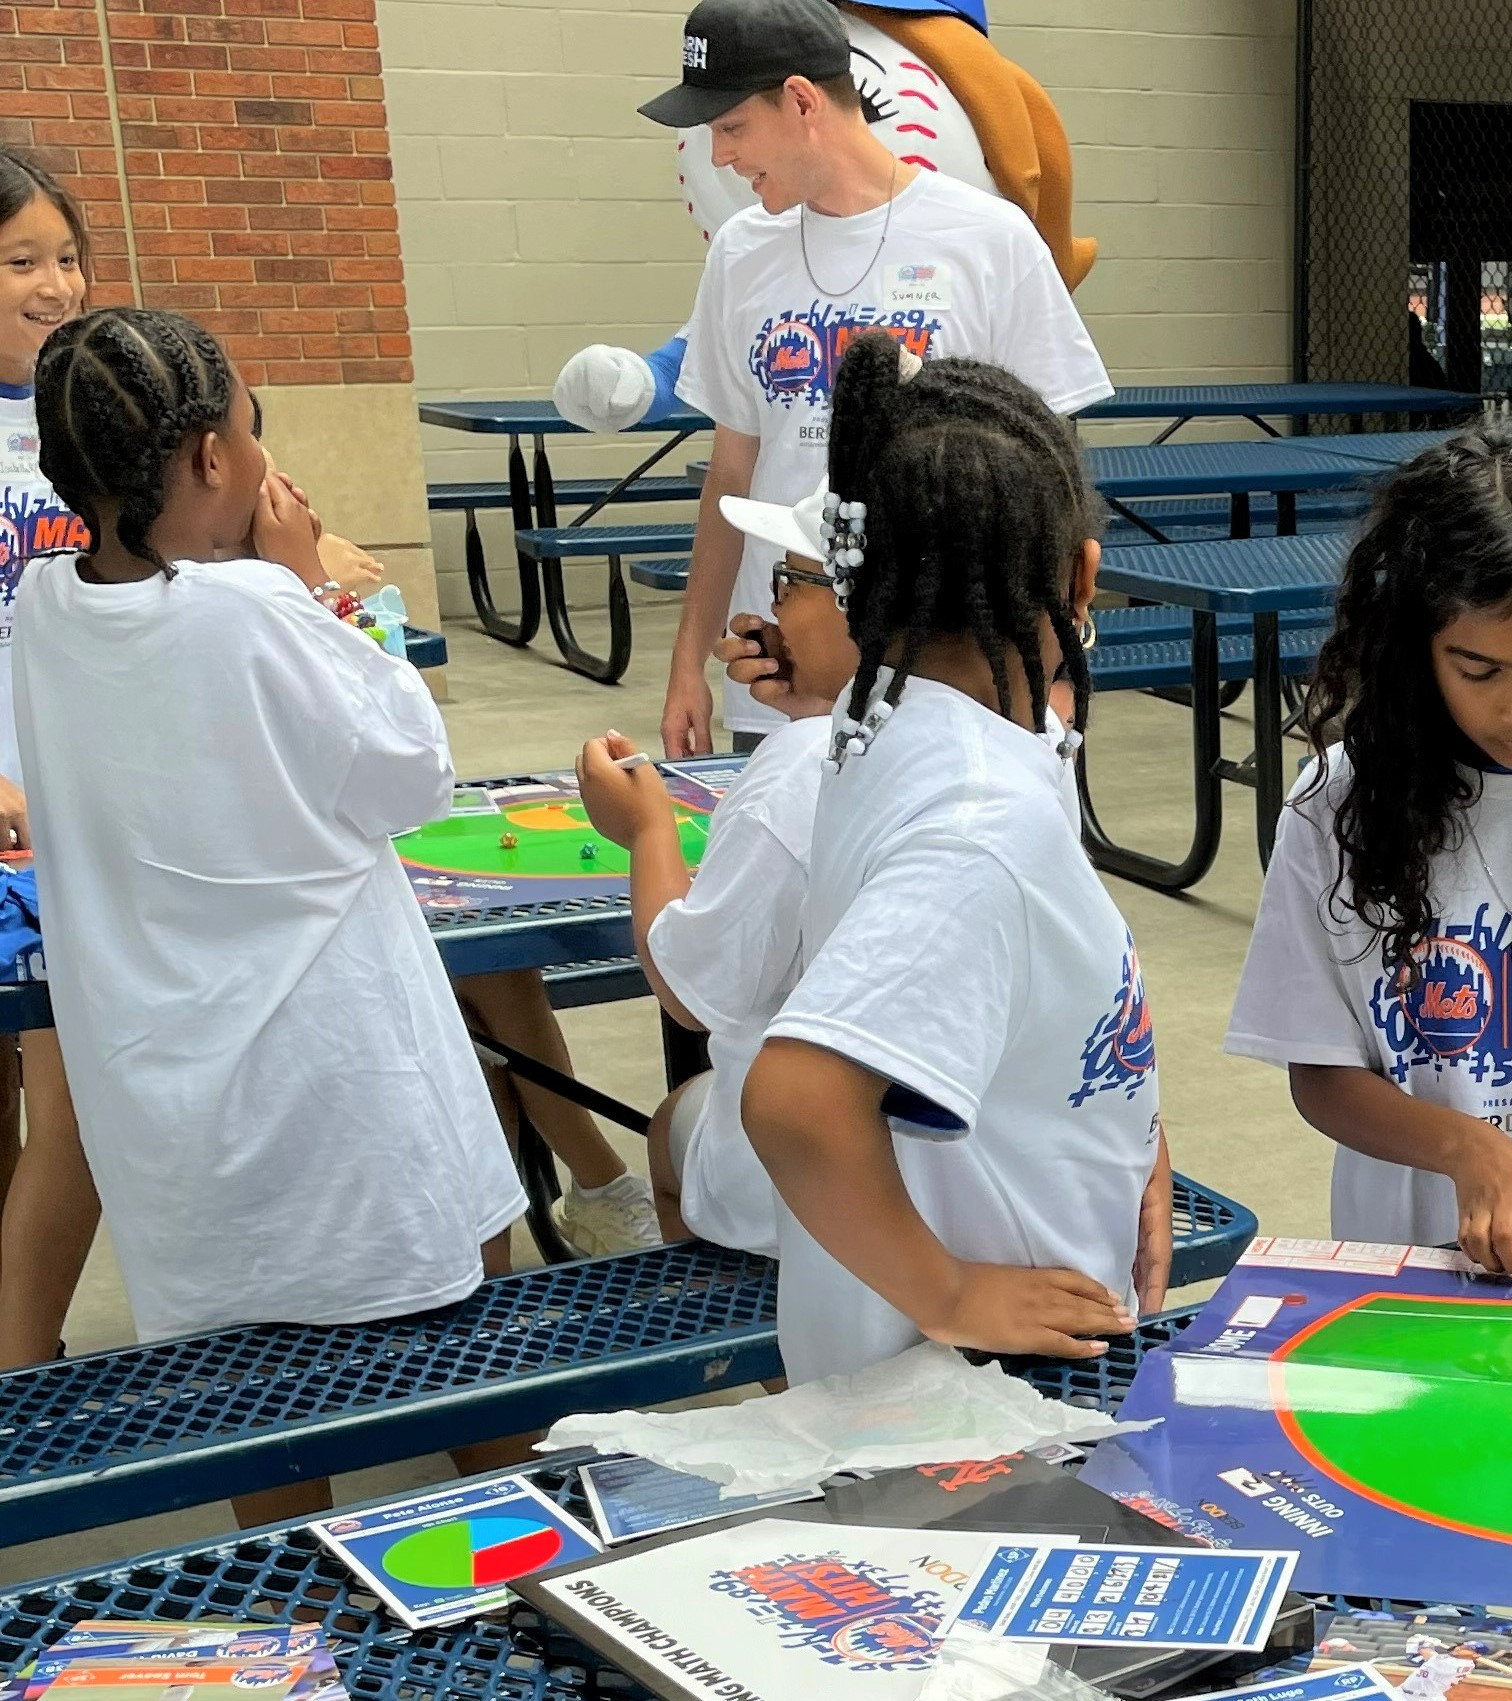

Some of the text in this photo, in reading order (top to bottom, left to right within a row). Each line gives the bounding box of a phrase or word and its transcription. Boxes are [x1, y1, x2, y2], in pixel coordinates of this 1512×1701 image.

[892, 291, 942, 301] SUMNER
[1419, 981, 1479, 1021] Mets
[383, 1496, 464, 1521] Pete Alonso
[1261, 1495, 1335, 1538] INNING
[1300, 1492, 1345, 1519] OUTS
[565, 1579, 679, 1651] CHAMPIONS
[972, 1596, 994, 1614] Pedro
[119, 1671, 206, 1681] Tom Seaver
[661, 1646, 723, 1688] MATH
[1268, 1688, 1304, 1701] Lugo
